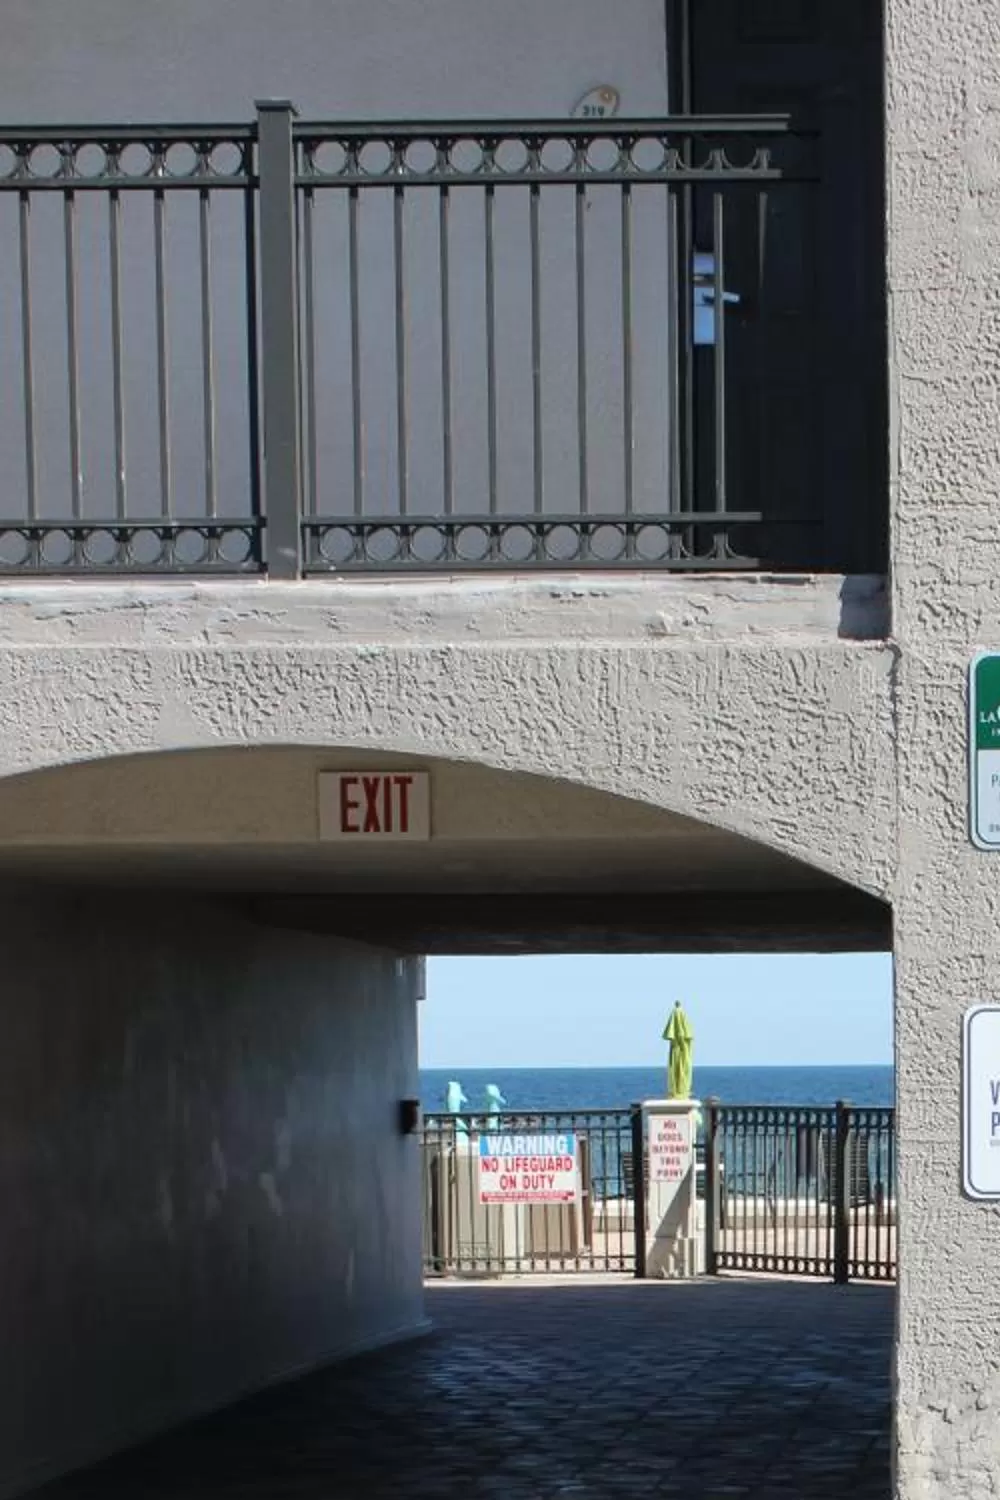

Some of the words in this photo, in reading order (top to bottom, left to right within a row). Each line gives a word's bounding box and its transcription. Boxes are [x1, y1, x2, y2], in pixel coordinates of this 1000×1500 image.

[340, 776, 413, 832] EXIT
[487, 1136, 567, 1155] WARNING
[482, 1157, 499, 1172] NO
[505, 1156, 573, 1172] LIFEGUARD
[500, 1174, 516, 1190] ON
[522, 1174, 555, 1190] DUTY
